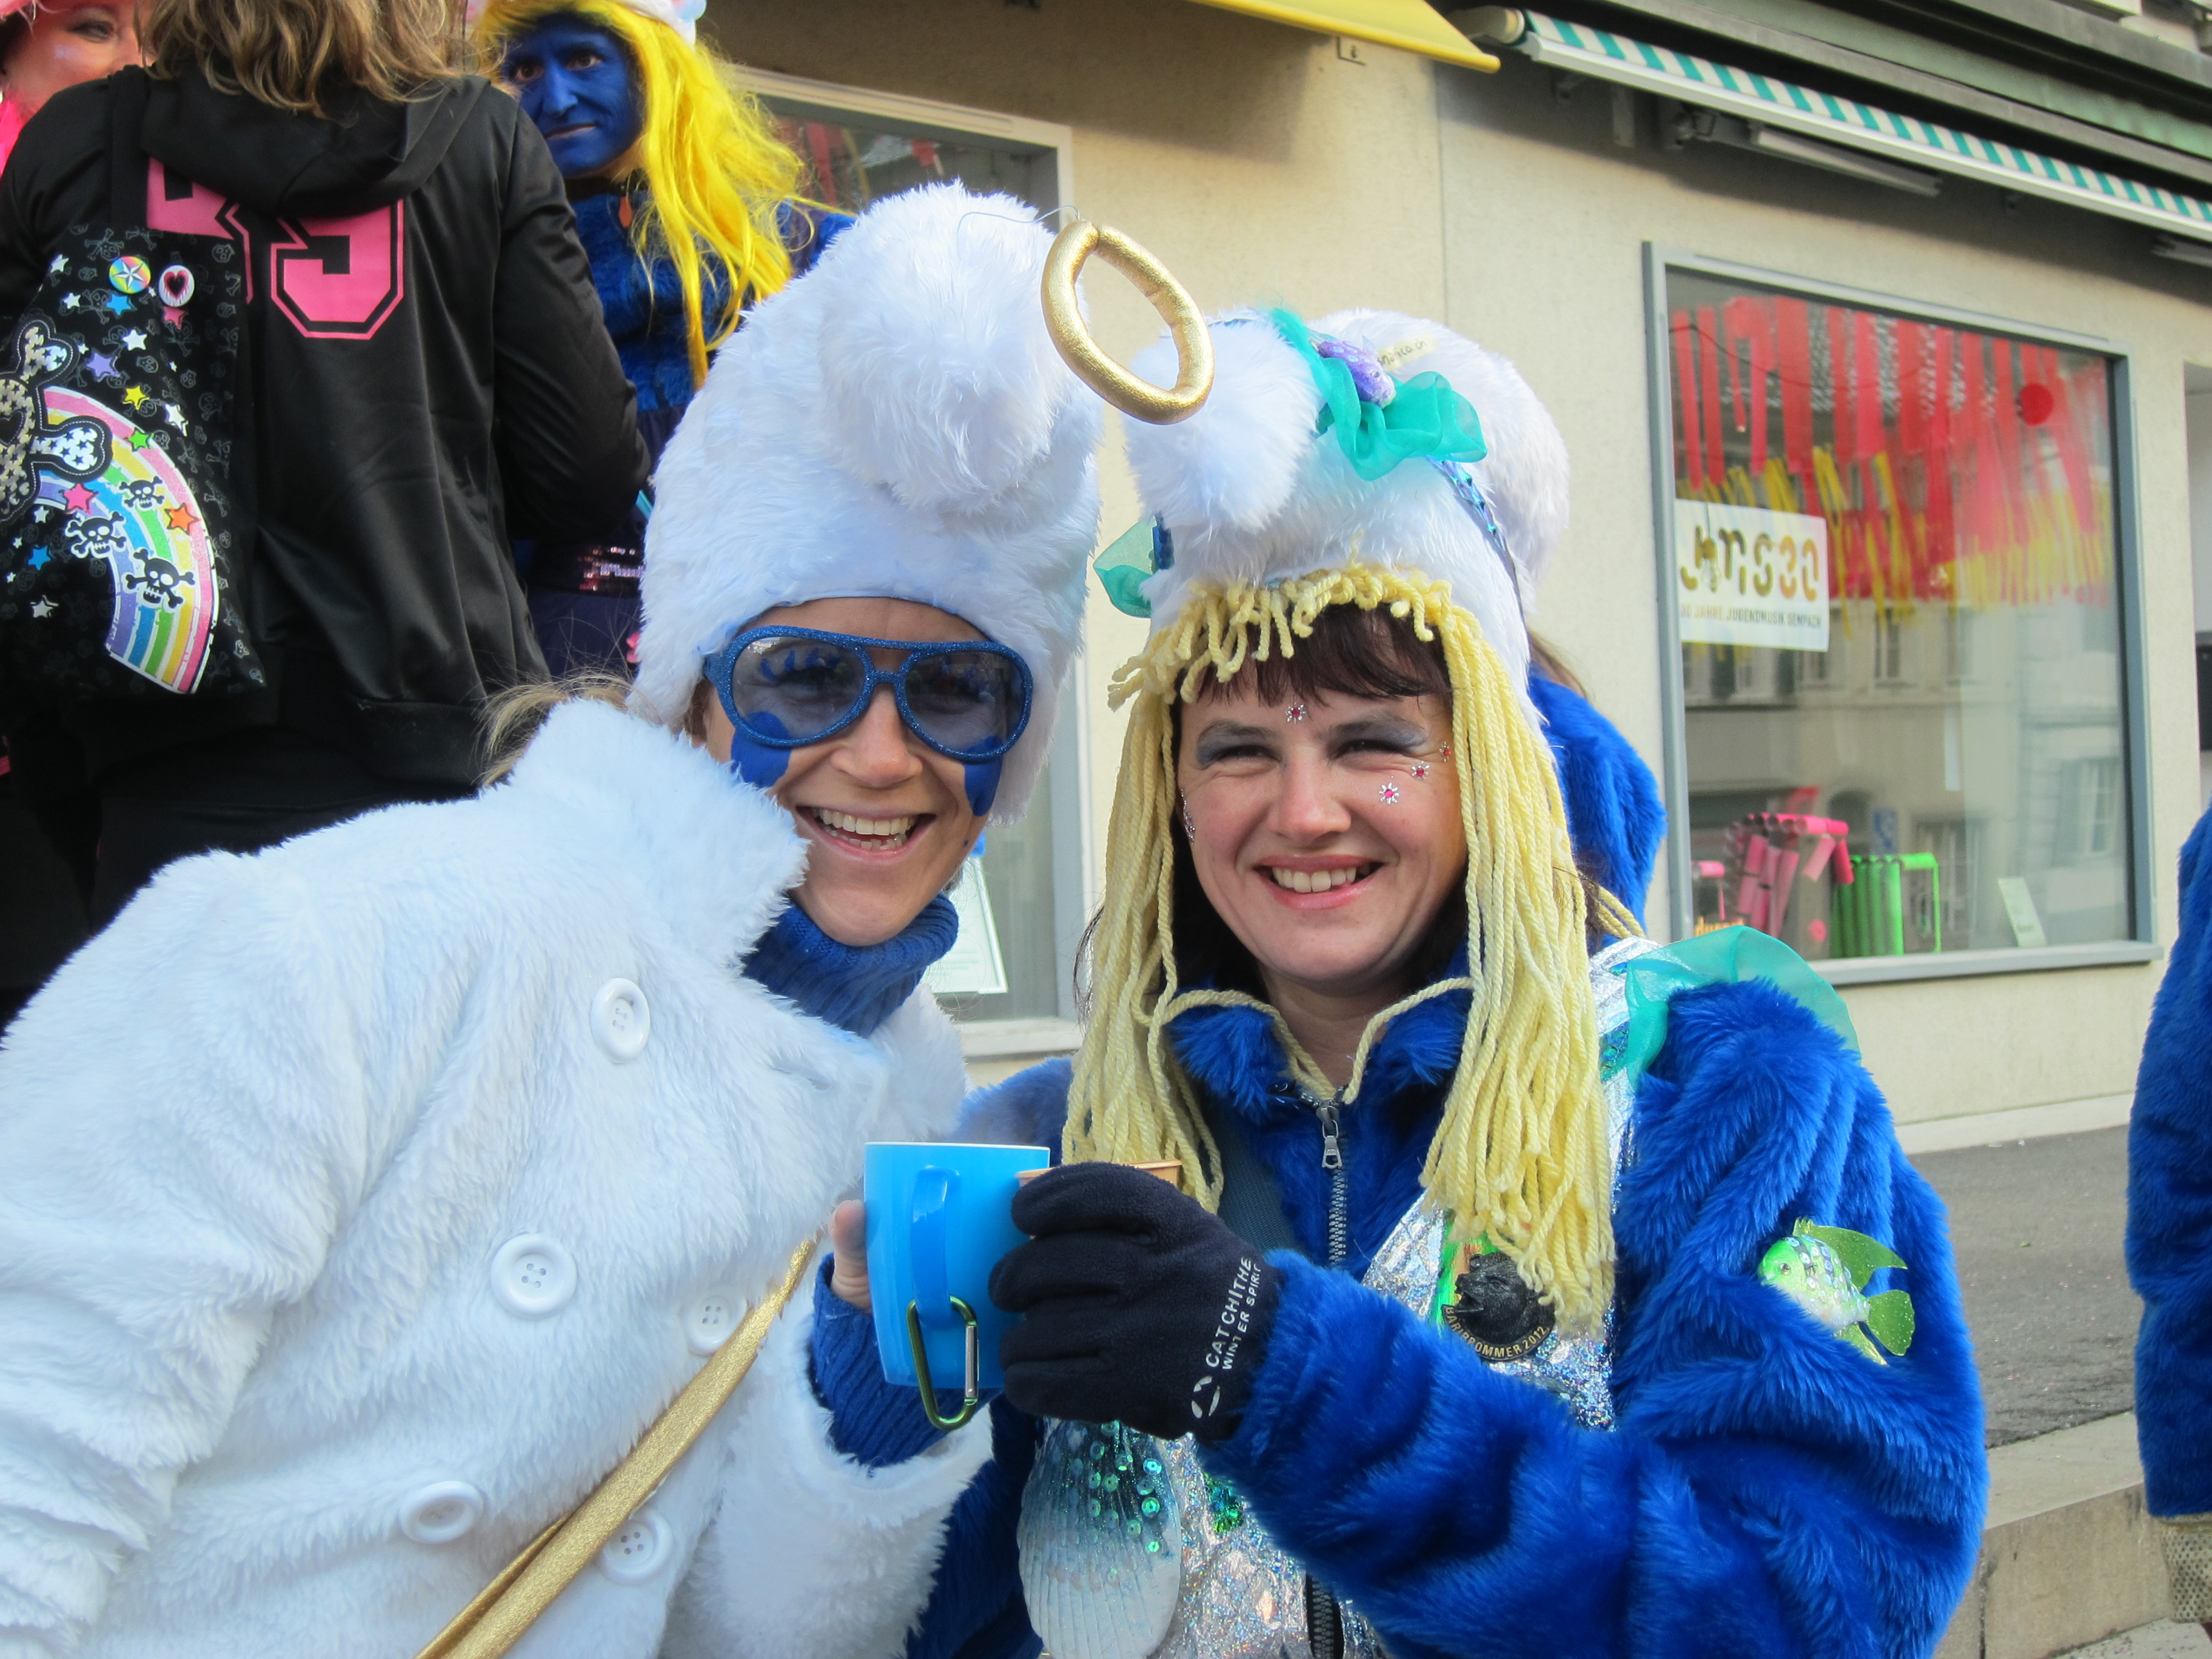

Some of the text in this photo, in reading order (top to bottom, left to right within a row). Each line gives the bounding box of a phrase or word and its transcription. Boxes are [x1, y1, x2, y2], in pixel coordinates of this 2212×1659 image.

[1694, 606, 1723, 619] JAHRE
[1727, 608, 1785, 624] JUGENDMUSIK
[1788, 612, 1822, 628] SEMPACH
[1246, 1264, 1261, 1306] SPIRIT
[1523, 1326, 1548, 1350] 2012
